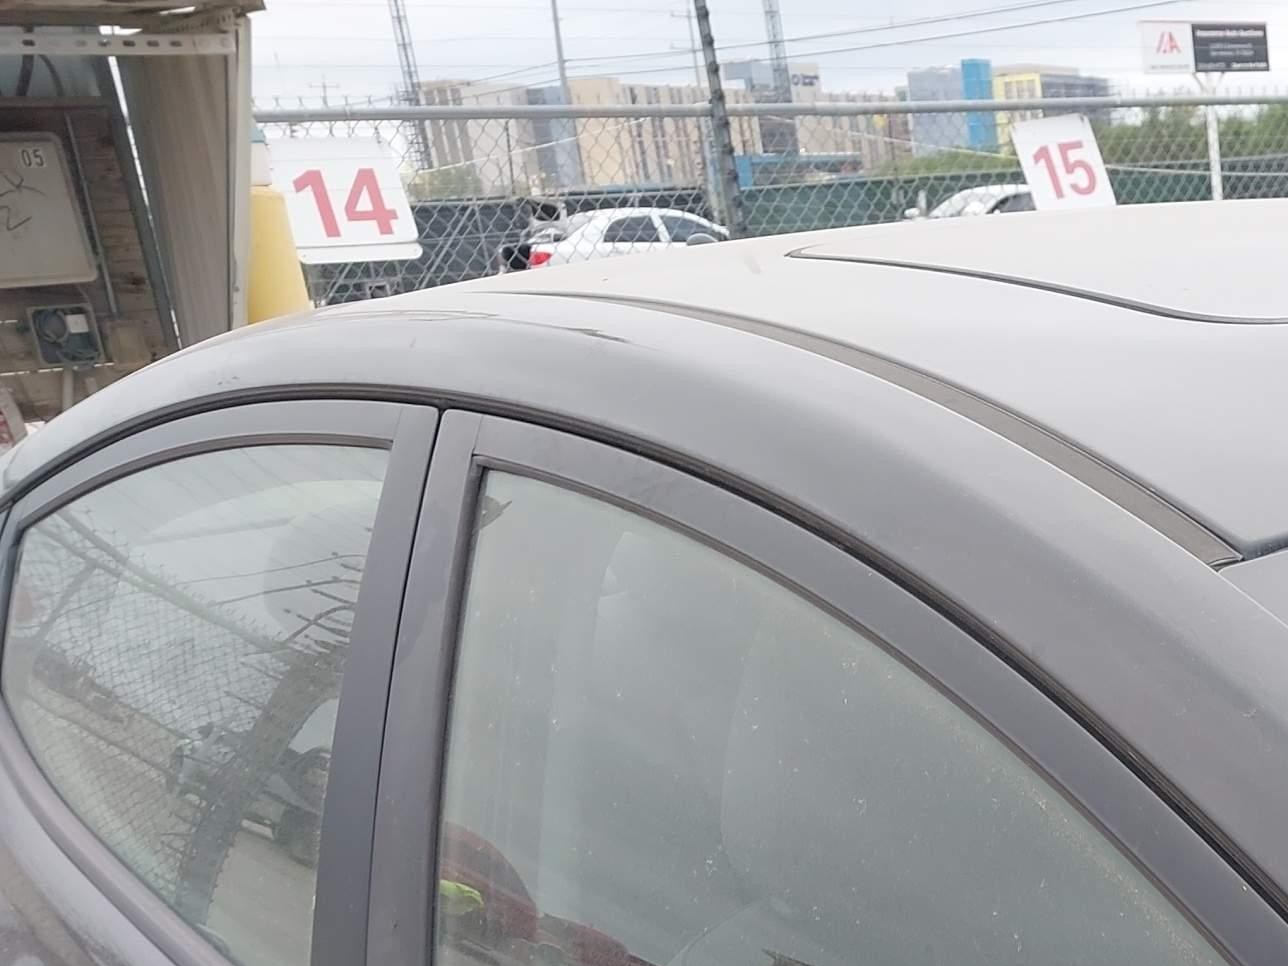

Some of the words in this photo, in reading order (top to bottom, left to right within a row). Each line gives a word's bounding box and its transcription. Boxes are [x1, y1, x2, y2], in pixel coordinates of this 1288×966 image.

[21, 148, 45, 168] 05
[1033, 140, 1097, 199] 15
[293, 168, 398, 237] 14
